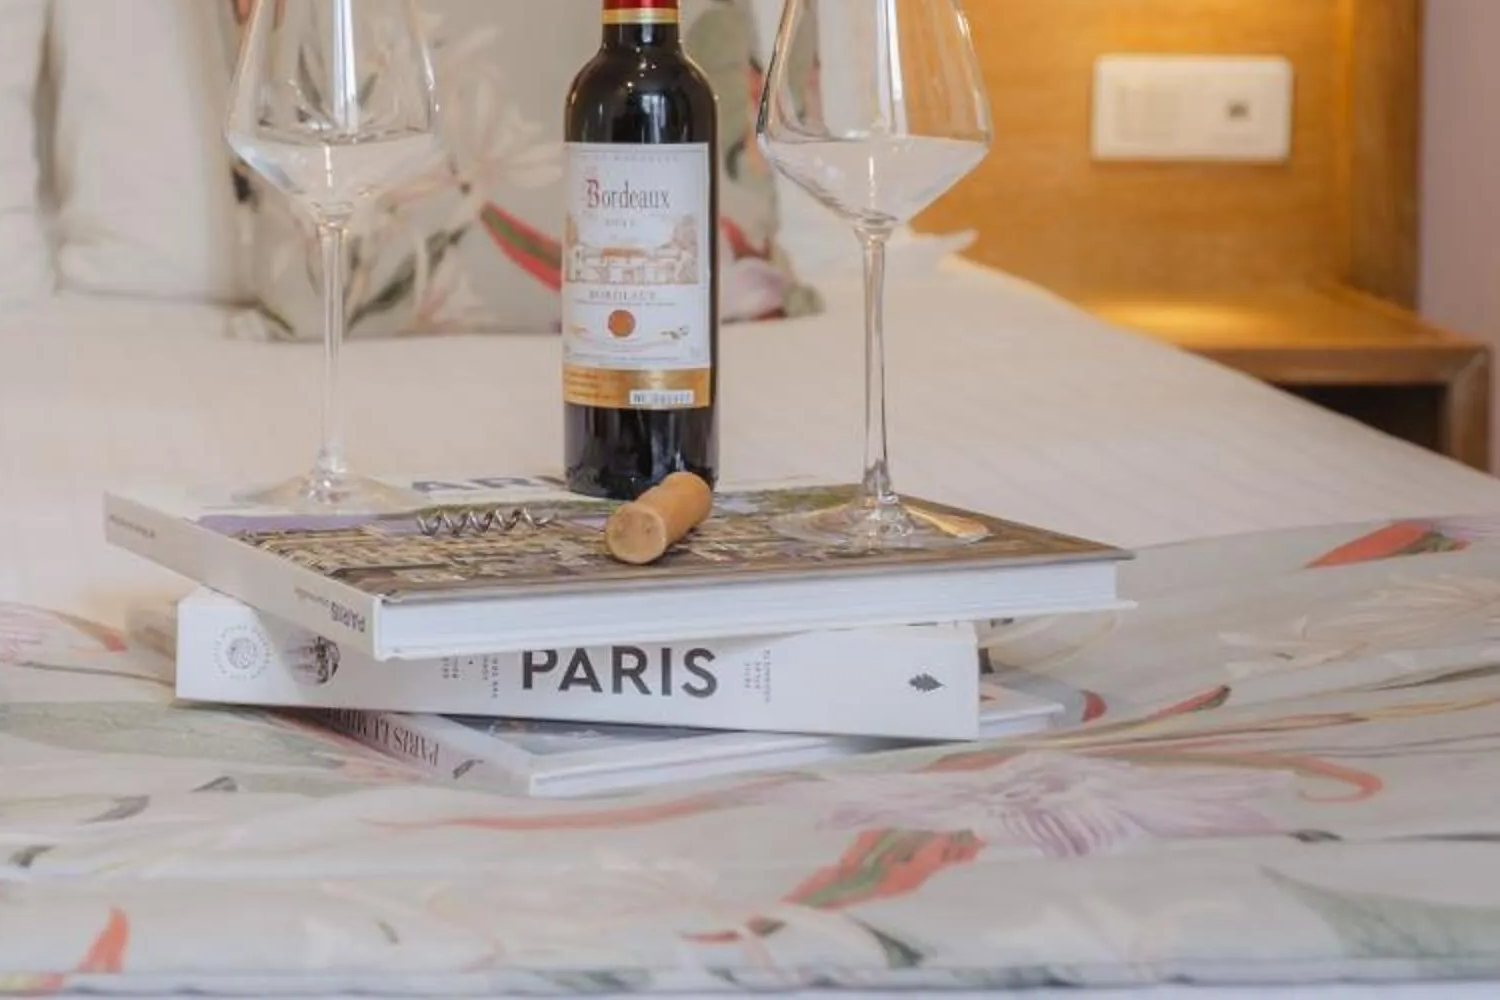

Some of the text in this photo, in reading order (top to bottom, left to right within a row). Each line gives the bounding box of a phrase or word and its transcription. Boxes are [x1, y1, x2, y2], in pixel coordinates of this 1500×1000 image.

[585, 178, 671, 209] Bordeaux
[331, 601, 366, 633] PARIS
[522, 645, 718, 699] PARIS
[393, 727, 439, 767] PARIS
